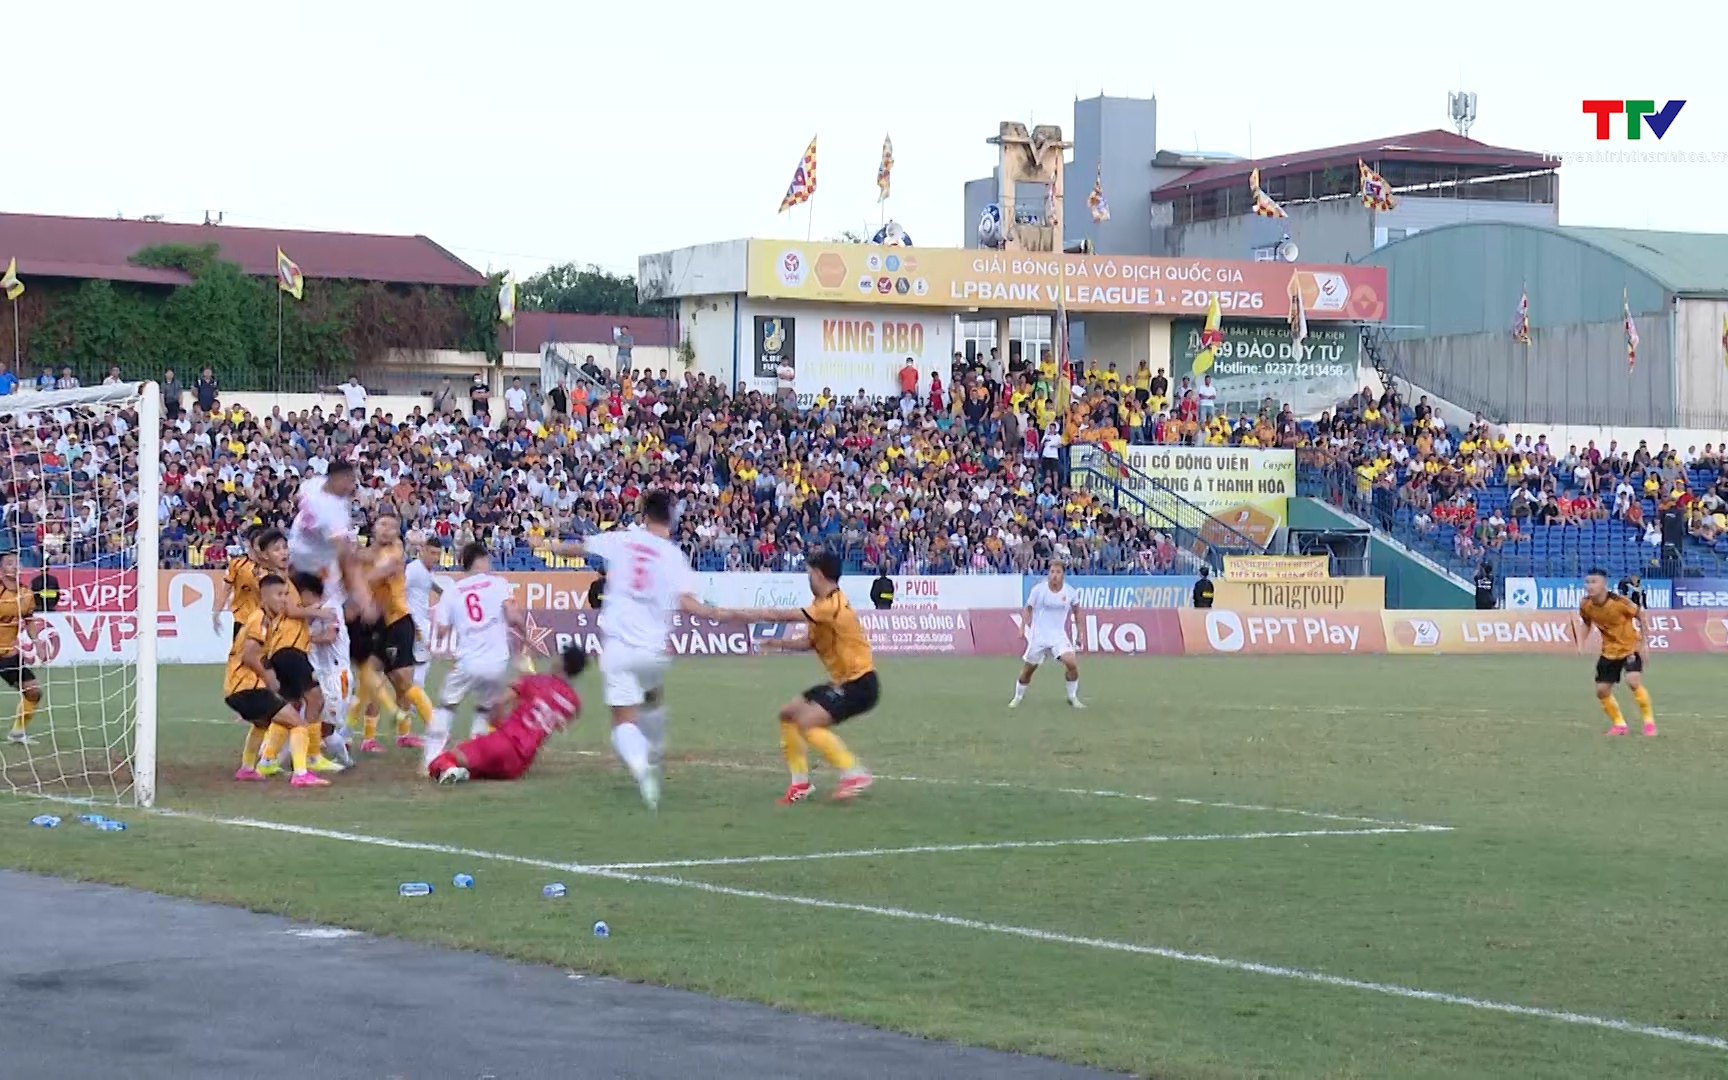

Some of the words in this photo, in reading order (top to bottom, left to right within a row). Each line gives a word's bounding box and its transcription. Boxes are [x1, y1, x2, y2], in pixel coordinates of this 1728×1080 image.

[972, 254, 1006, 274] GIẢI
[1012, 257, 1059, 275] BÓNG
[1065, 259, 1088, 276] ĐÁ
[1093, 259, 1117, 278] VÔ
[1122, 264, 1161, 281] ĐỊCH
[1165, 261, 1212, 282] QUỐC
[1216, 269, 1243, 283] GIA
[951, 281, 1041, 302] LPBANK
[1046, 285, 1059, 302] V
[1065, 286, 1150, 305] LEAGUE
[1154, 289, 1166, 306] 1
[822, 319, 875, 352] KING
[881, 321, 924, 357] BBQ
[1236, 337, 1276, 358] ĐÀO
[1214, 361, 1262, 375] Hotline:
[1216, 452, 1250, 472] VIÊN
[1257, 476, 1286, 494] HÓA
[905, 580, 940, 596] PVOIL
[465, 592, 483, 622] 6
[669, 629, 749, 655] VÀNG
[1247, 617, 1298, 644] FPT
[1302, 617, 1360, 650] Play
[1461, 620, 1572, 643] LPBANK
